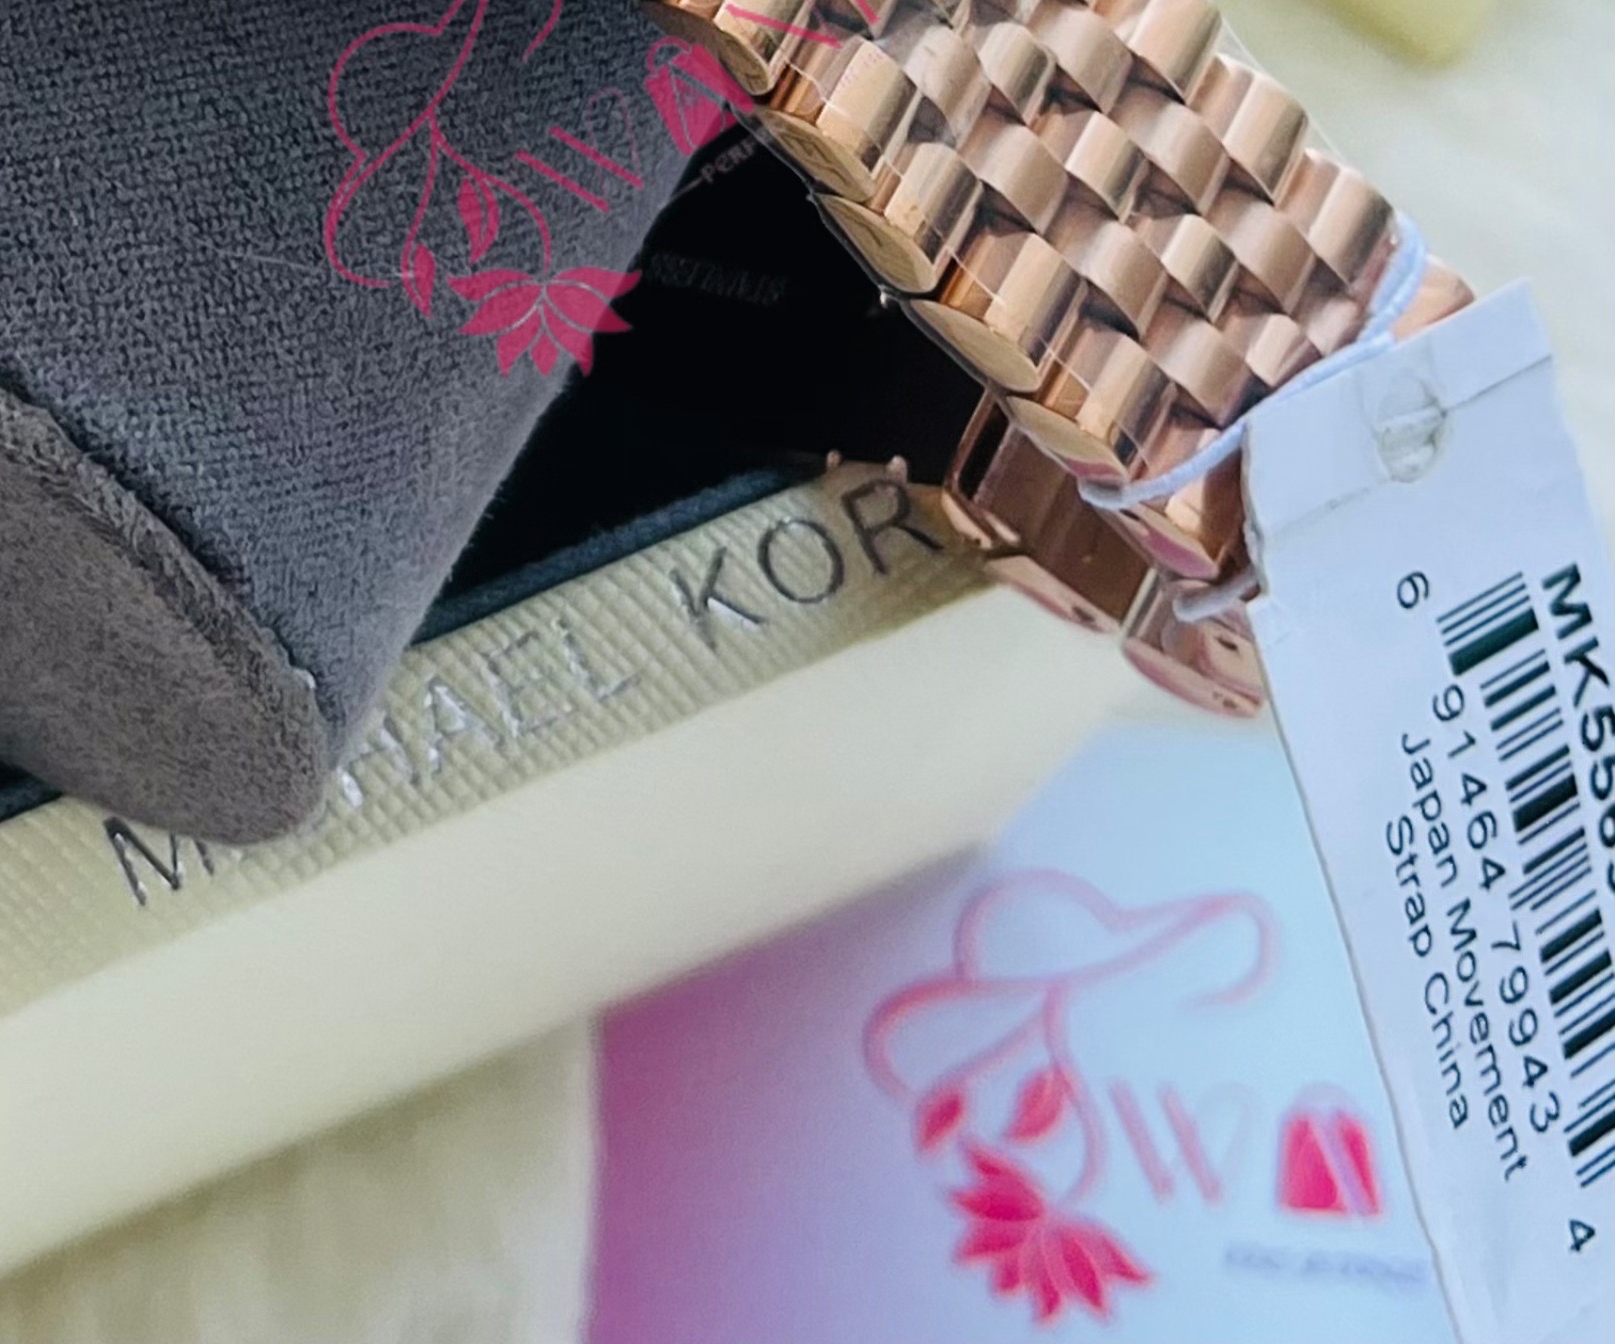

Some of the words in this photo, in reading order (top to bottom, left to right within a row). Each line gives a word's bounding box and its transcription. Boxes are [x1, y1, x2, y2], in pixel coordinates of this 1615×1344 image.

[668, 476, 944, 650] KOR
[1386, 814, 1433, 959] Strap
[1424, 971, 1470, 1129] China
[1397, 570, 1431, 611] 6
[1431, 683, 1506, 893] 91464
[1490, 919, 1562, 1134] 79943
[1569, 1218, 1597, 1254] 4
[1401, 732, 1459, 889] Japan
[1447, 897, 1529, 1183] Movement
